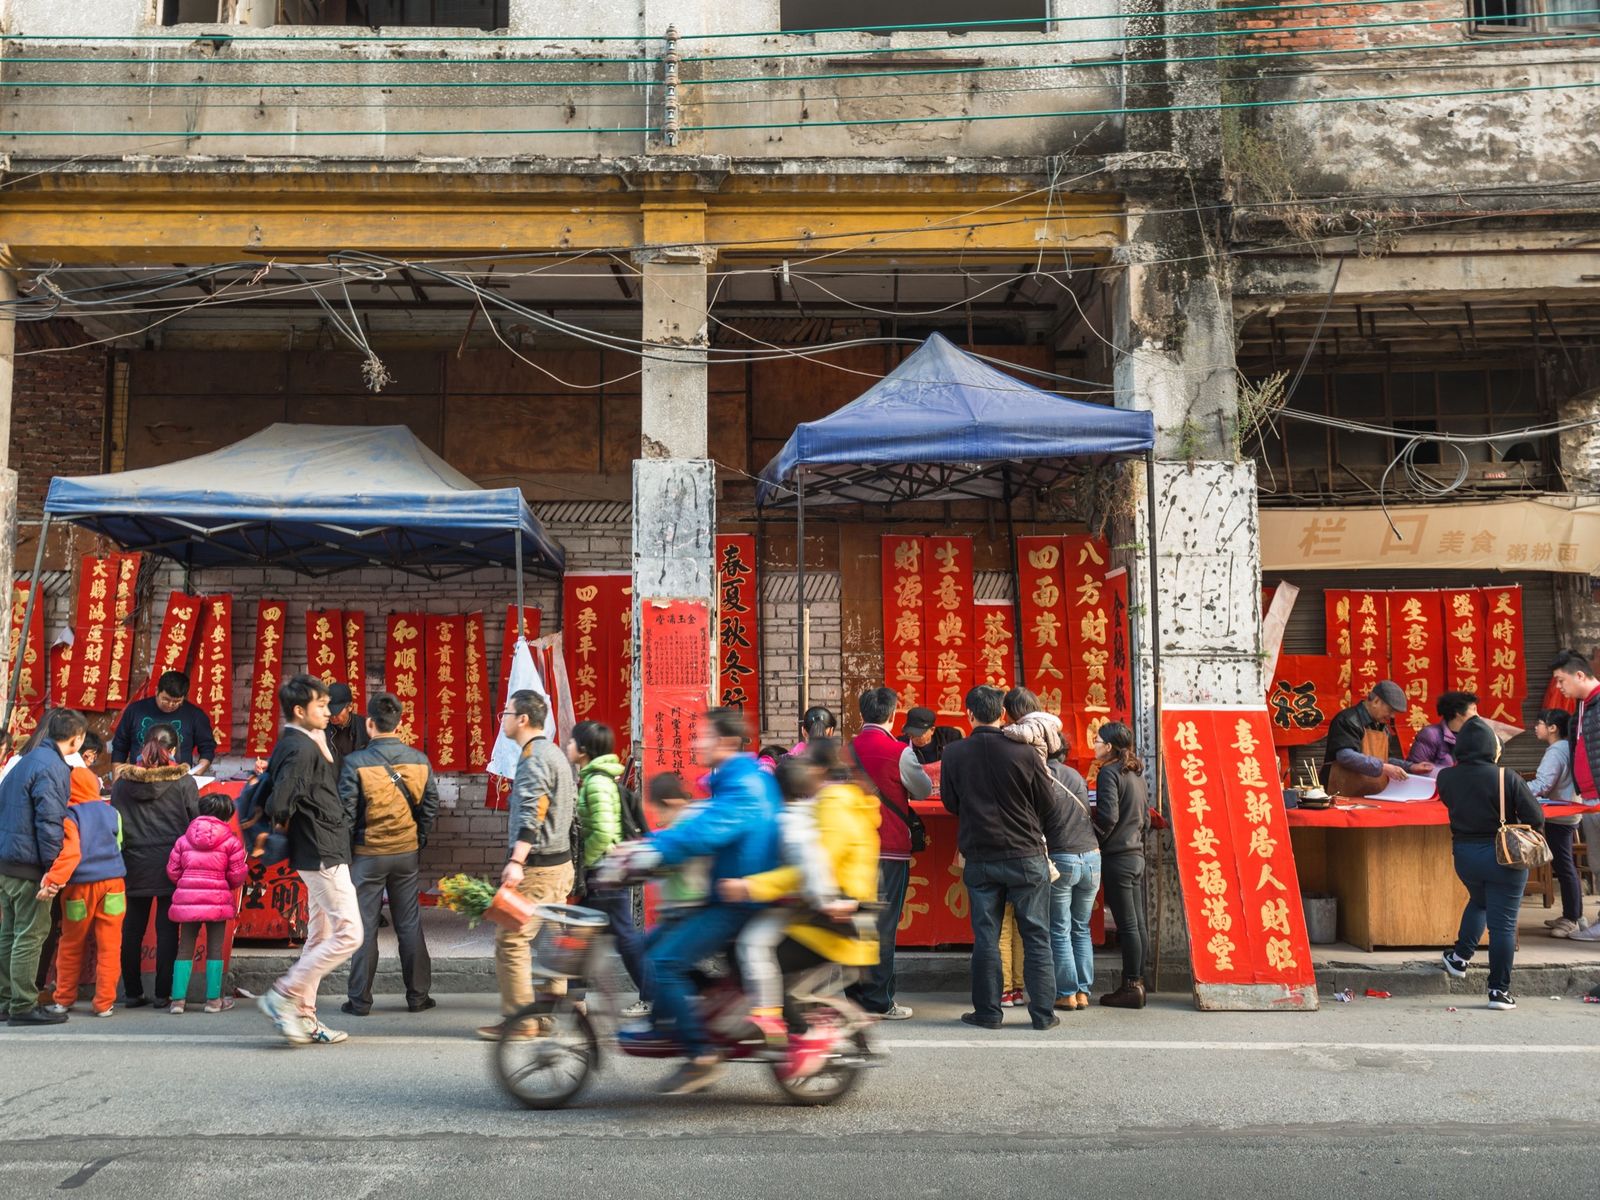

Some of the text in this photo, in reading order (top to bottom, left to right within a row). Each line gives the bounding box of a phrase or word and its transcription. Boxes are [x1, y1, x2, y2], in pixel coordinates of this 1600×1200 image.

[1437, 529, 1497, 555] 美食
[1506, 542, 1580, 562] 粥粉面
[250, 606, 282, 753] 四季平安福滿堂
[1270, 680, 1325, 731] 福
[1174, 721, 1237, 972] 住宅平安福滿堂
[1230, 719, 1298, 972] 喜進新居人財旺
